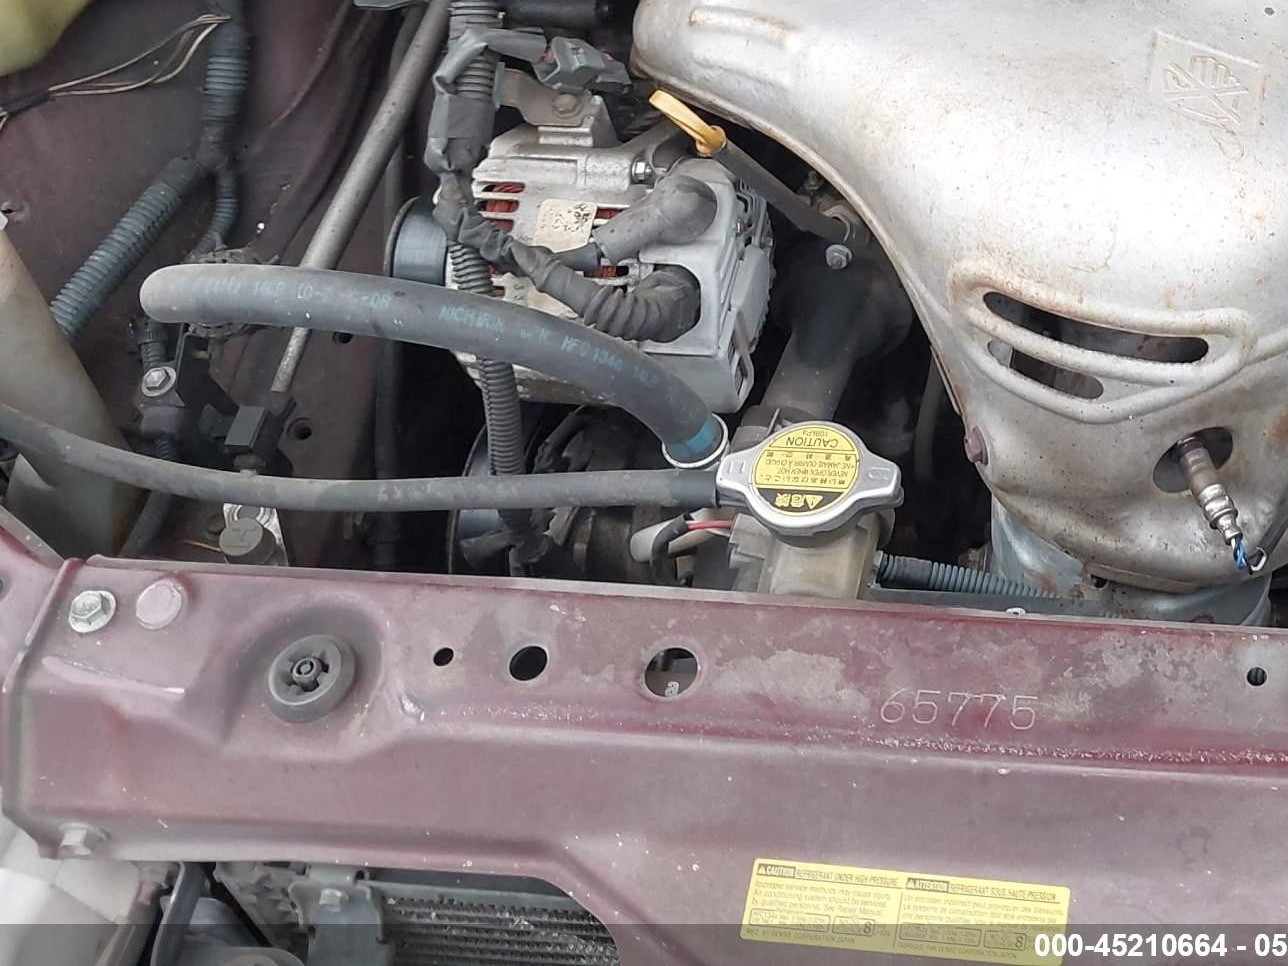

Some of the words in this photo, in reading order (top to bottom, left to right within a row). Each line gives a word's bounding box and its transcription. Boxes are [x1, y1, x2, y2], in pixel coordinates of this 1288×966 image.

[786, 437, 839, 448] CAUTION
[880, 688, 1038, 730] 65775
[766, 866, 795, 878] CAUTION
